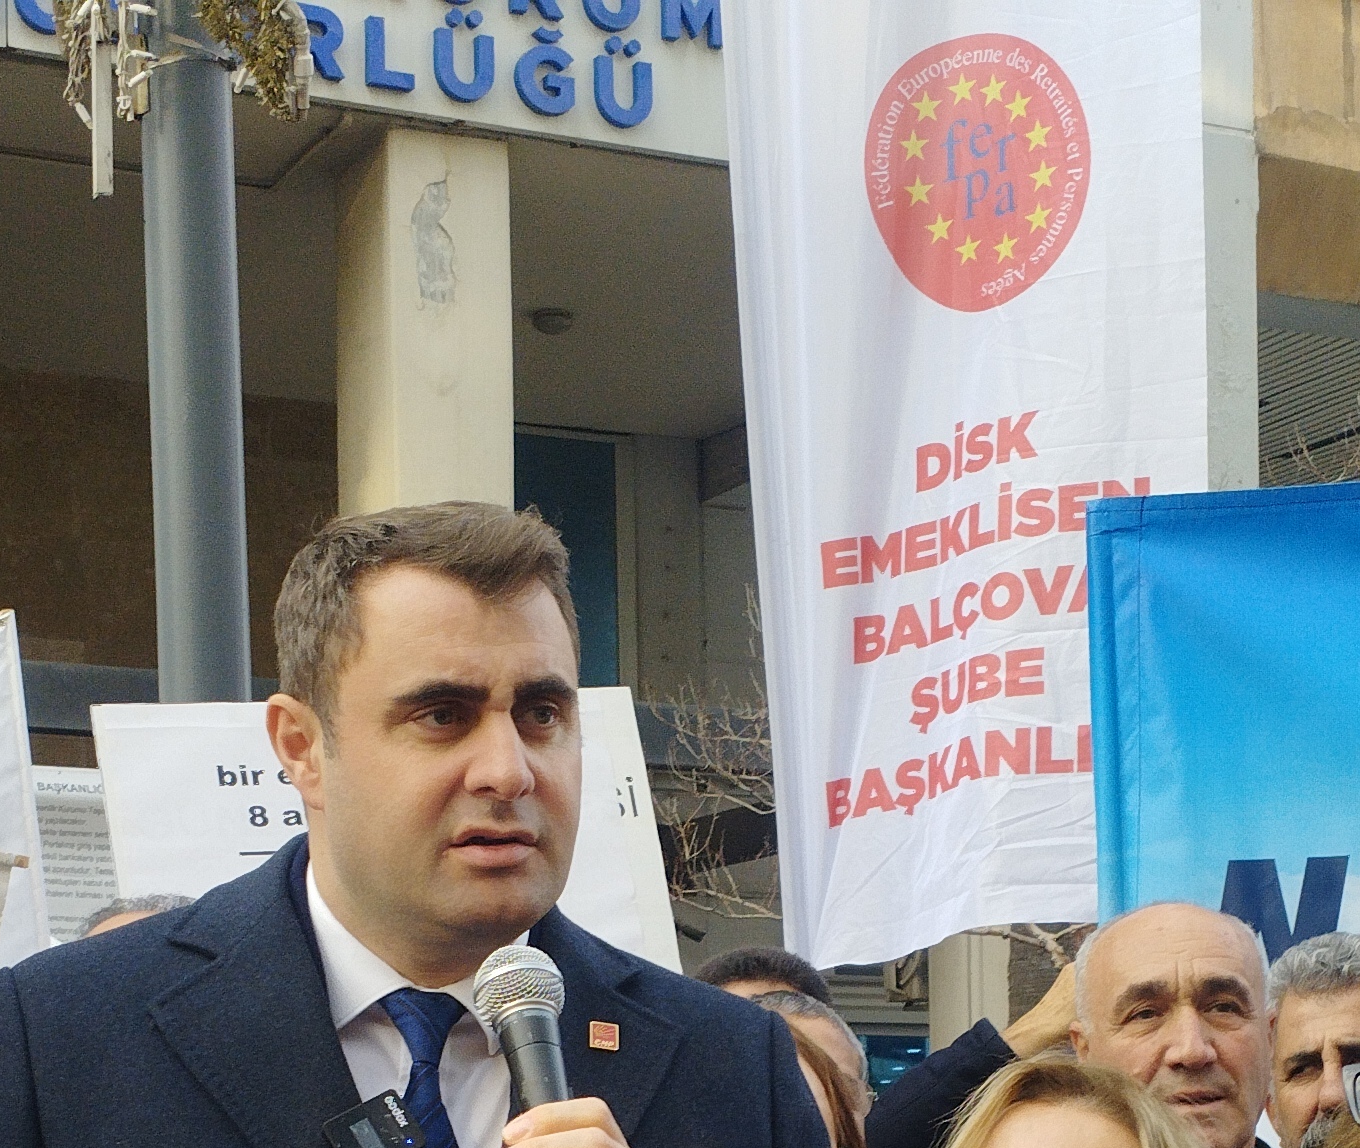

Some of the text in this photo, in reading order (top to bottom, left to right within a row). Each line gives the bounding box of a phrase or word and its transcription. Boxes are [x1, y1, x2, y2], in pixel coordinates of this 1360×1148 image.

[897, 47, 1004, 100] Européenne
[1005, 47, 1032, 74] des
[1030, 63, 1078, 139] Retraités
[871, 99, 905, 210] Fédération
[1065, 141, 1081, 161] et
[1029, 167, 1084, 264] Personnes
[915, 409, 1039, 494] DİSK
[910, 646, 1046, 734] ŞUBE
[216, 764, 265, 787] bir
[248, 805, 269, 828] 8
